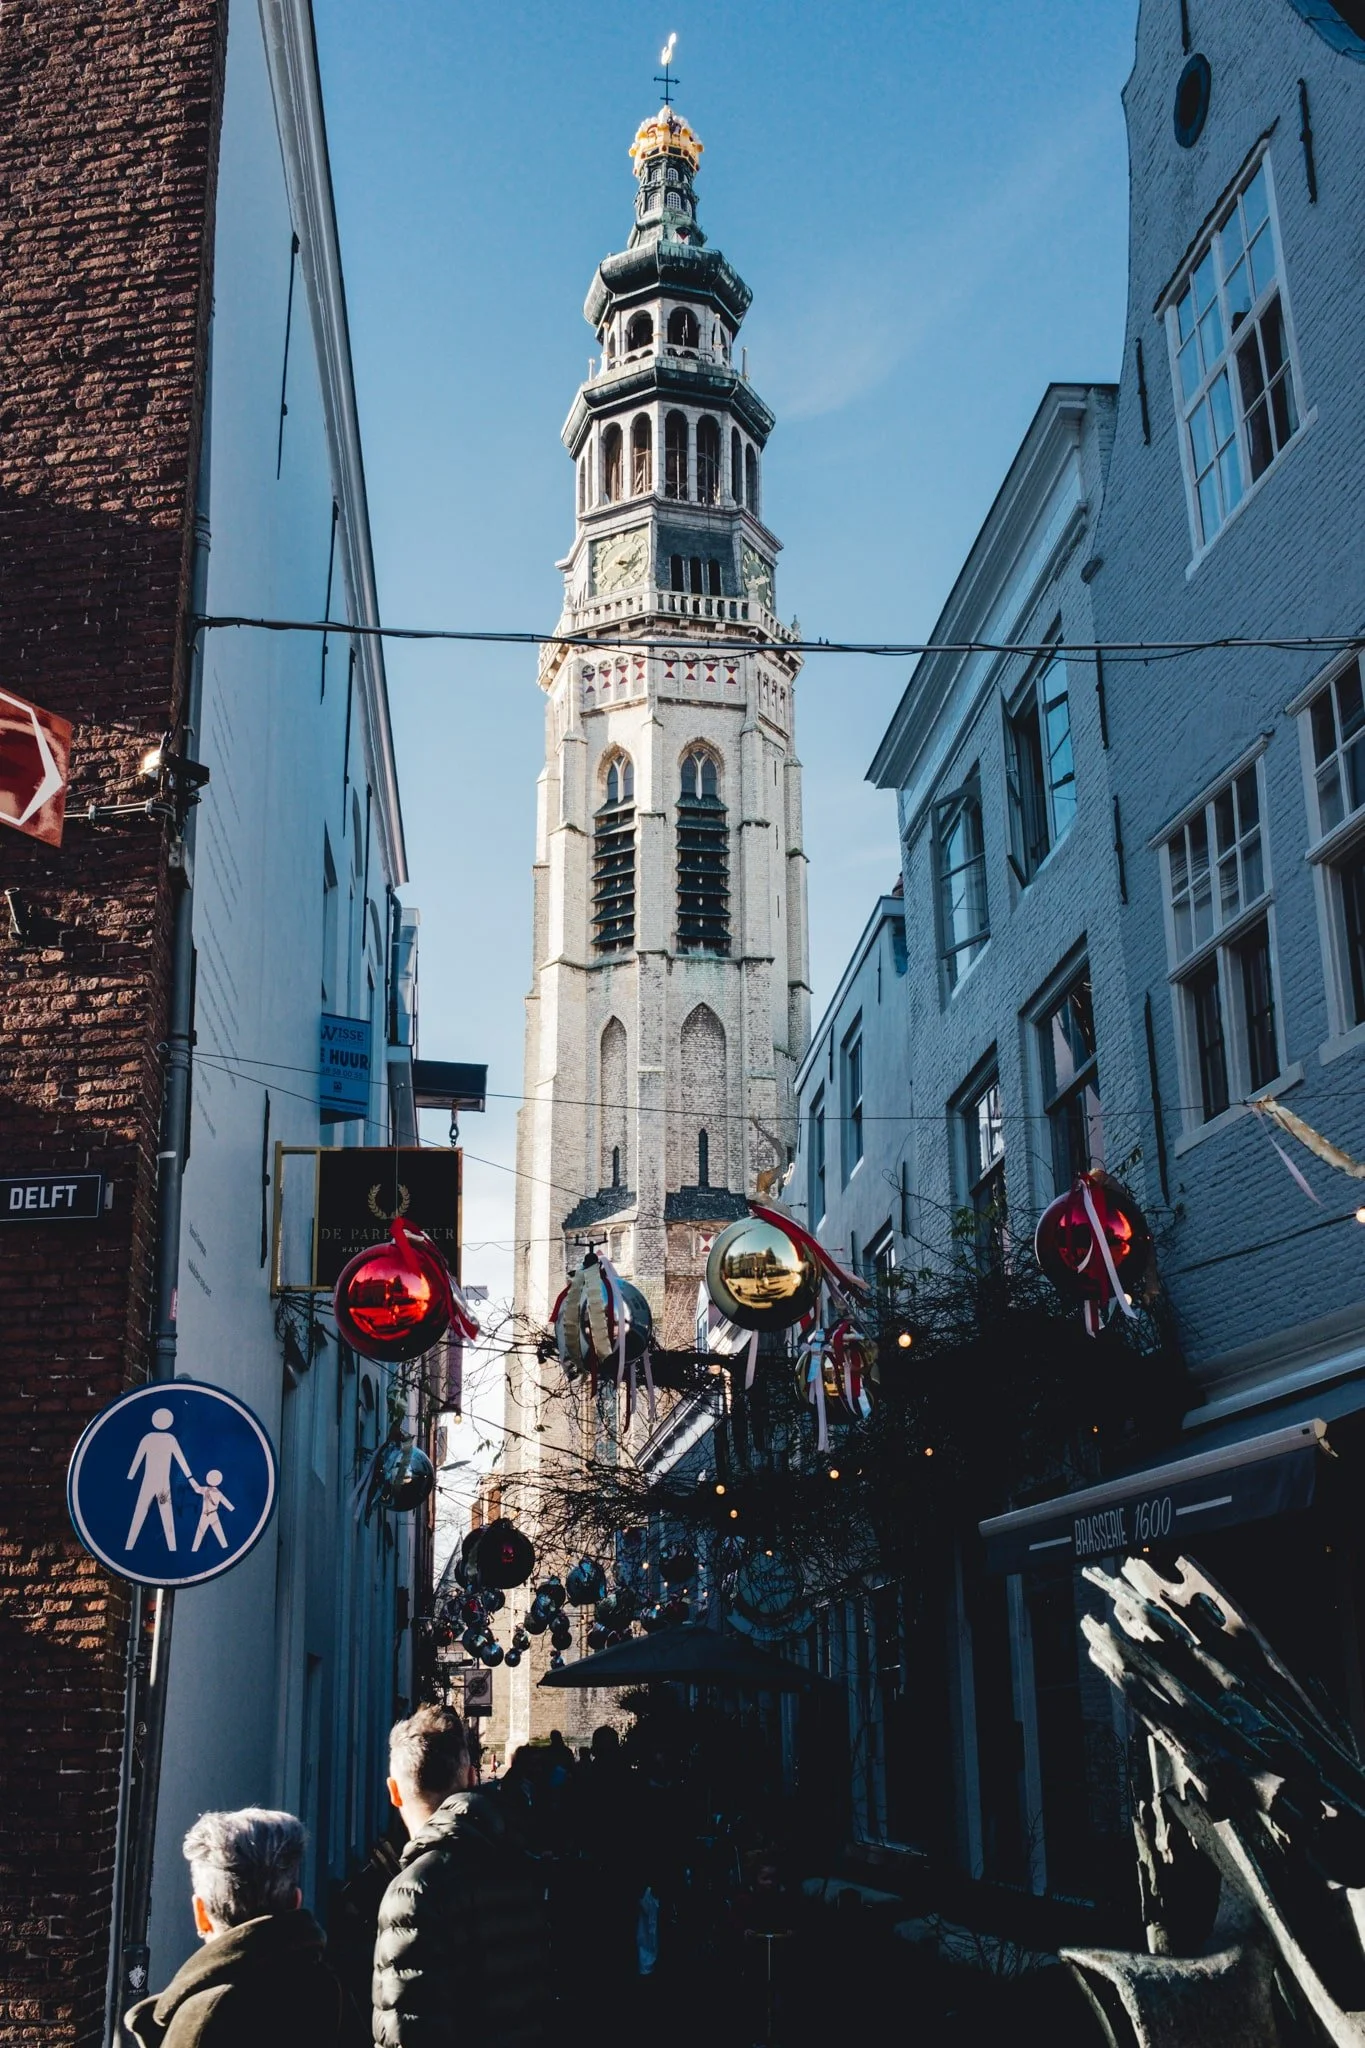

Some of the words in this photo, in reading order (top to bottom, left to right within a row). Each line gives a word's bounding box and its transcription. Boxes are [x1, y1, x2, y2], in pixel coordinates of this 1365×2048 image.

[321, 1025, 365, 1042] WISSE
[329, 1048, 369, 1070] HUUR
[9, 1184, 78, 1210] DELFT
[320, 1228, 342, 1240] DE
[1074, 1507, 1128, 1556] BRASSERIE
[1134, 1496, 1172, 1541] 1600
